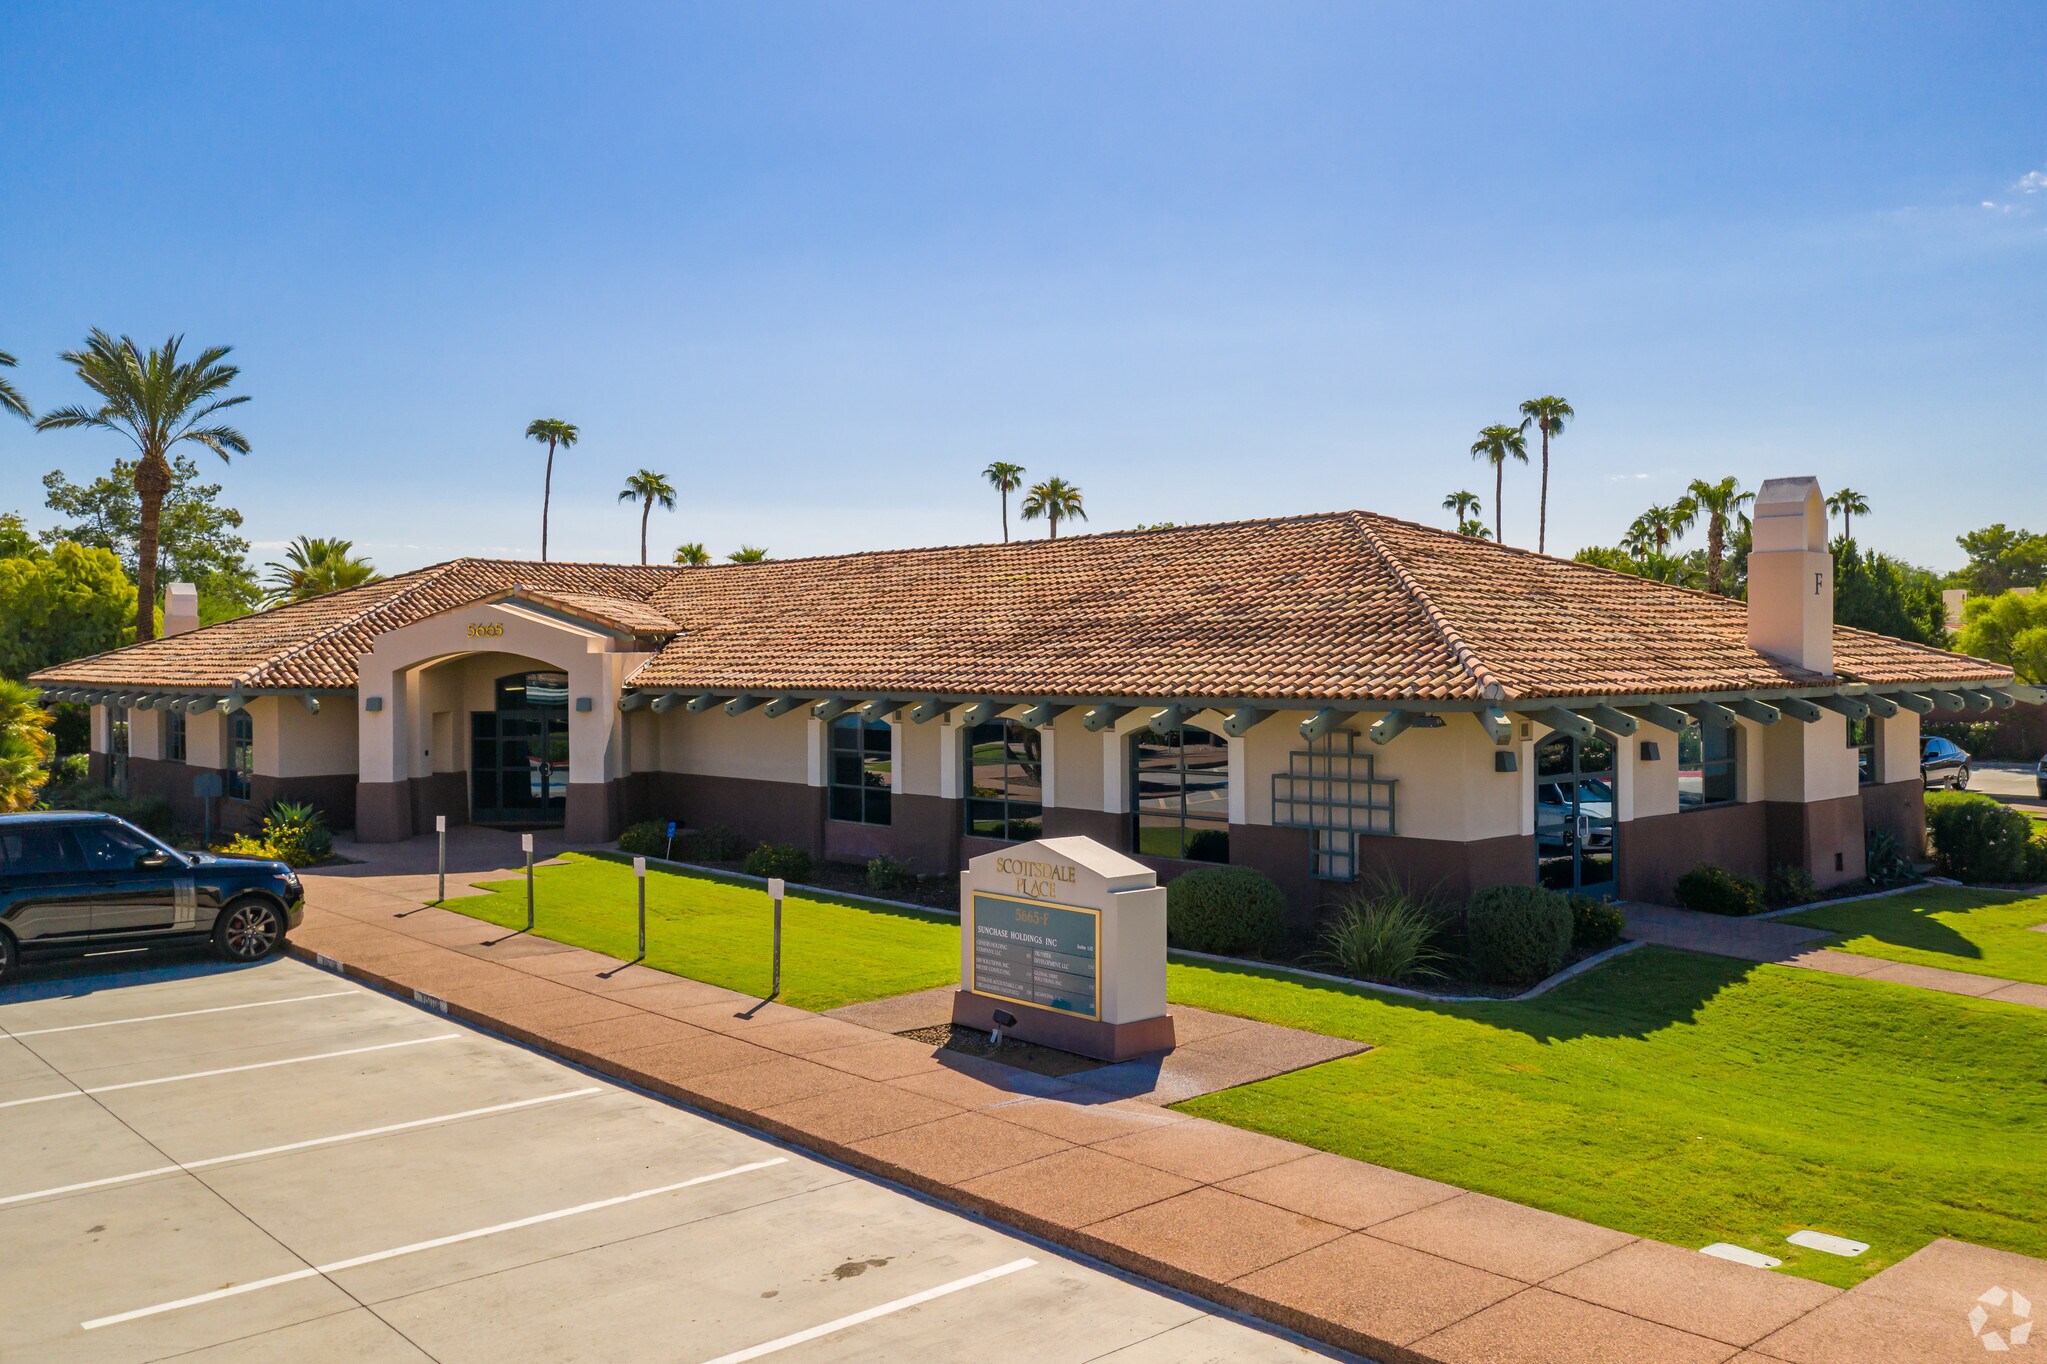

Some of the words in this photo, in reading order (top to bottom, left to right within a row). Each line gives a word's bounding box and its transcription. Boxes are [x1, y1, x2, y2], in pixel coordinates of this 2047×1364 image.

[1815, 572, 1822, 595] F
[466, 622, 503, 638] 5665
[996, 857, 1076, 883] SCOTTSDALE
[1016, 877, 1056, 898] PLACE
[1015, 908, 1050, 927] 5665-F
[977, 925, 1009, 938] SUNCHASE
[1045, 937, 1058, 947] INC
